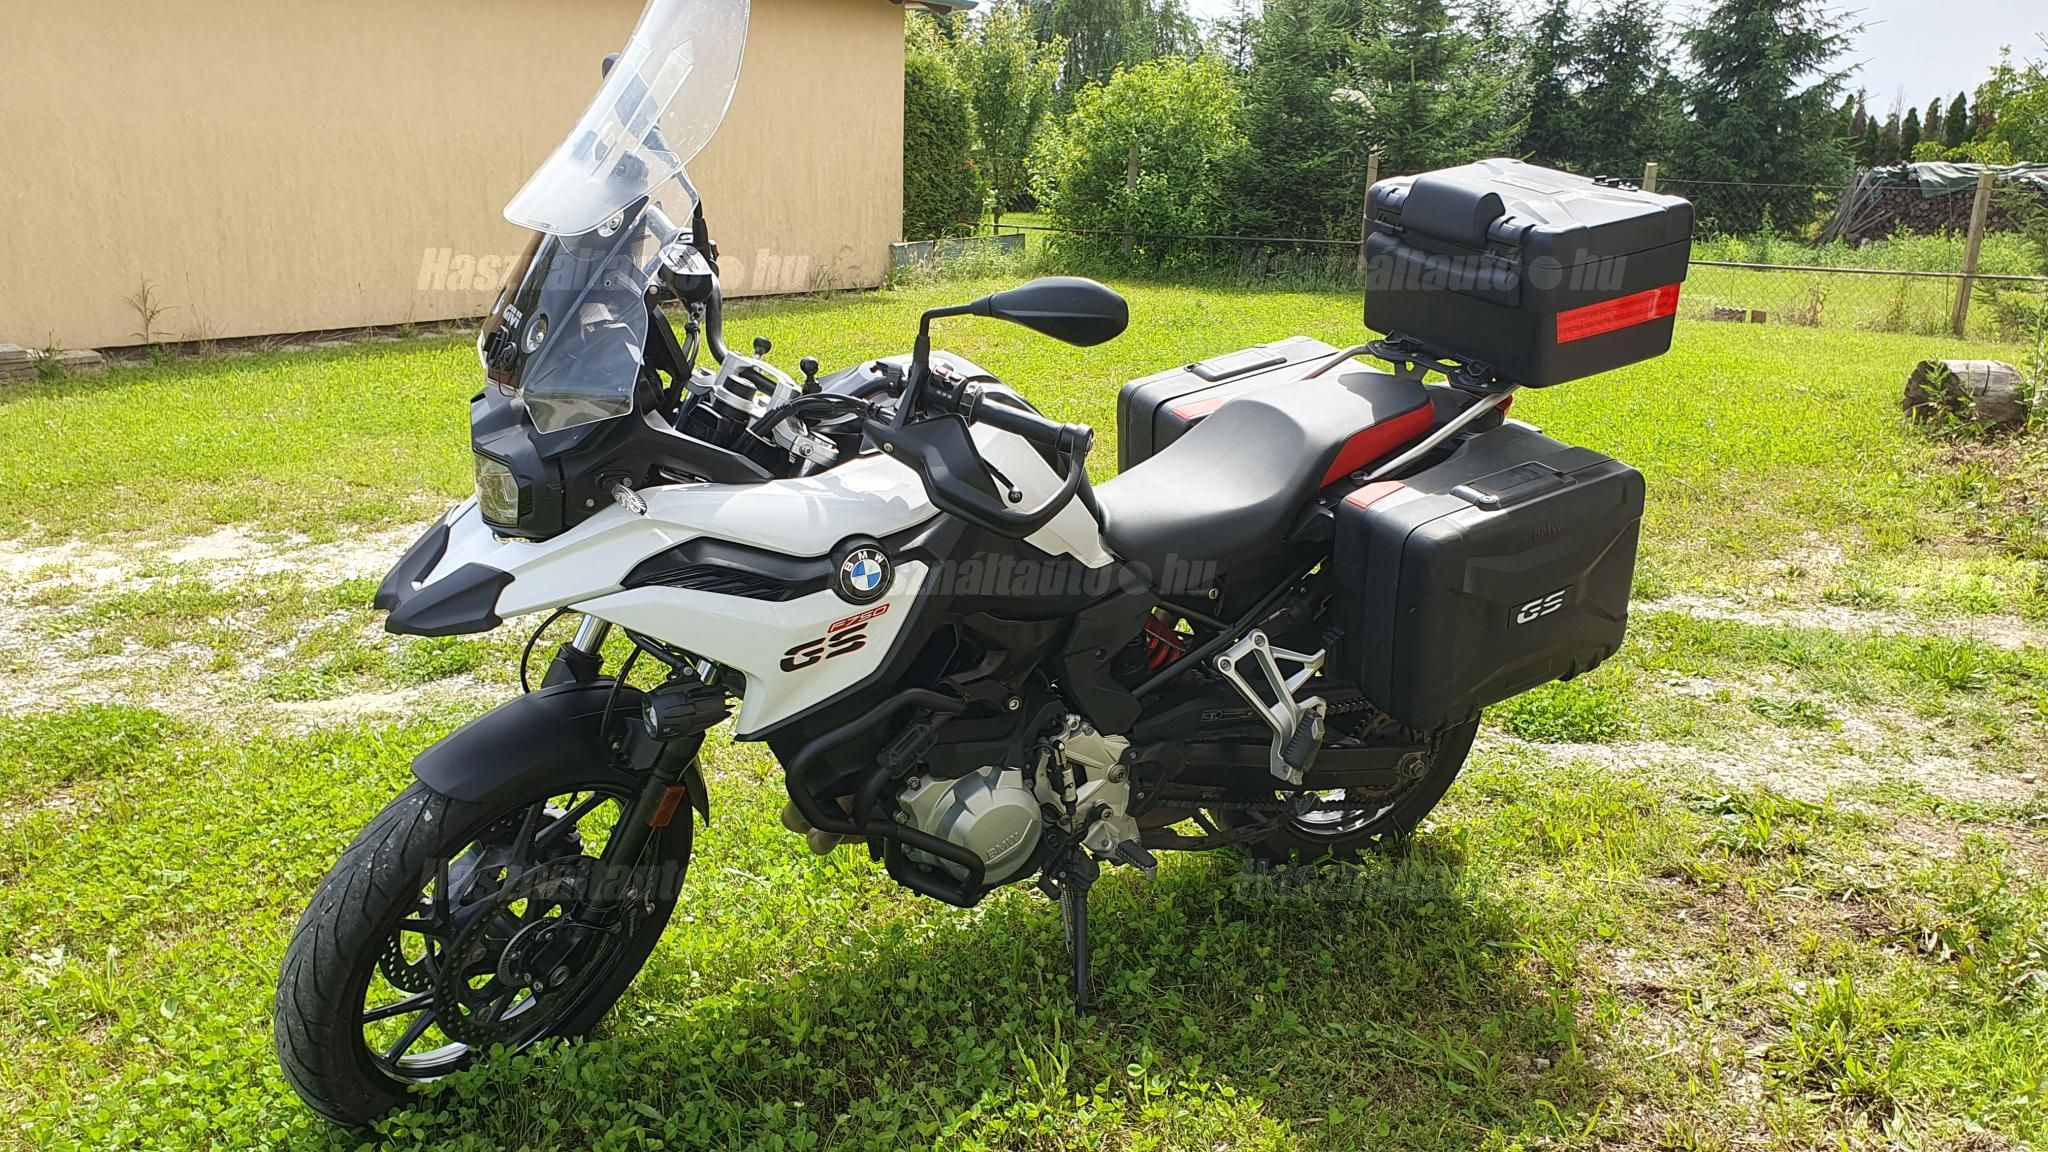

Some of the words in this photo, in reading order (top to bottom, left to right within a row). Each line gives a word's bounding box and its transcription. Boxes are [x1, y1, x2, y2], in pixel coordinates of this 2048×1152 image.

[843, 550, 885, 572] BMW
[831, 604, 888, 632] F750
[1517, 589, 1566, 625] GS
[780, 622, 869, 673] GS
